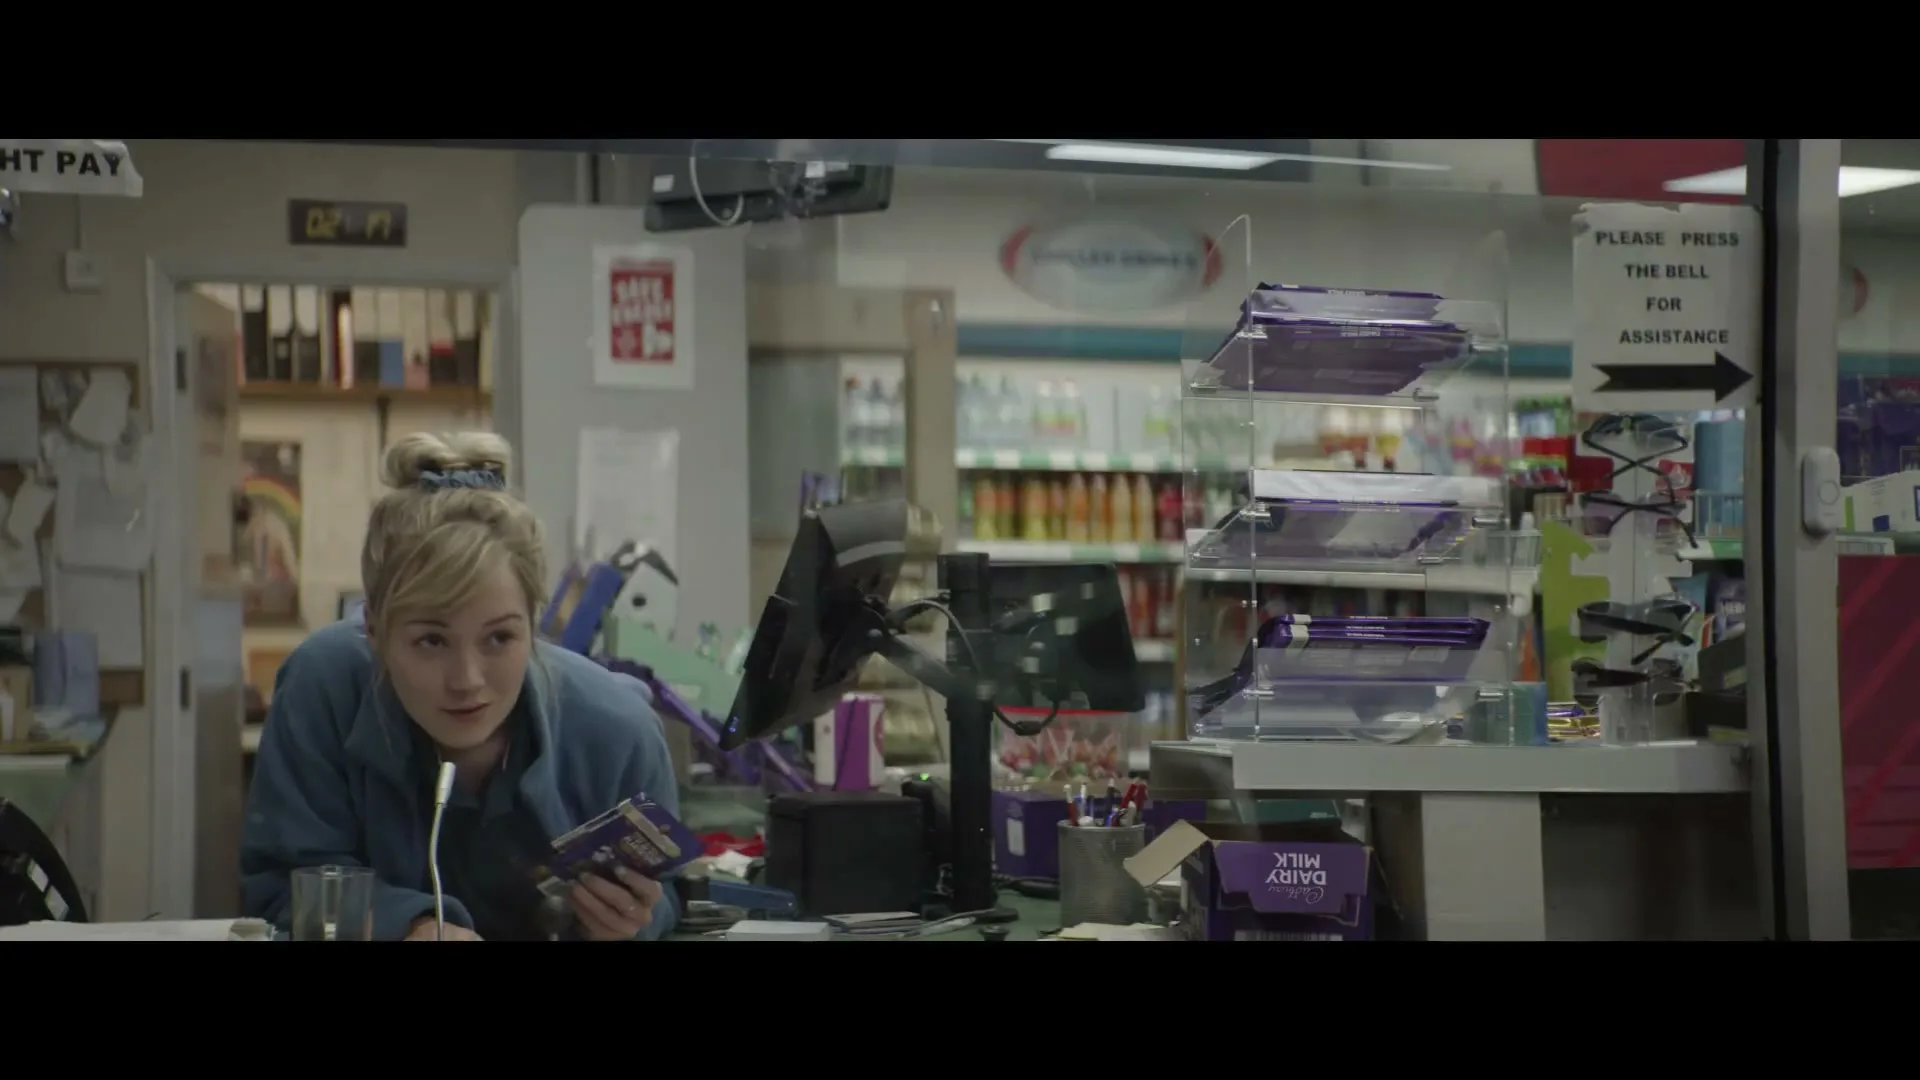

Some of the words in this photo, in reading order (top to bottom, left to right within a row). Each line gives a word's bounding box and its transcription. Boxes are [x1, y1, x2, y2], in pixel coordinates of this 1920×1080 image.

[56, 149, 121, 177] PAY
[1595, 231, 1665, 246] PLEASE
[1681, 231, 1740, 247] PRESS
[1624, 263, 1661, 279] THE
[1665, 264, 1709, 279] BELL
[1646, 297, 1682, 312] FOR
[1619, 329, 1730, 345] ASSISTANCE
[1273, 852, 1320, 869] MILK
[1265, 868, 1327, 886] DAIRY
[1267, 885, 1324, 905] Cadbury
